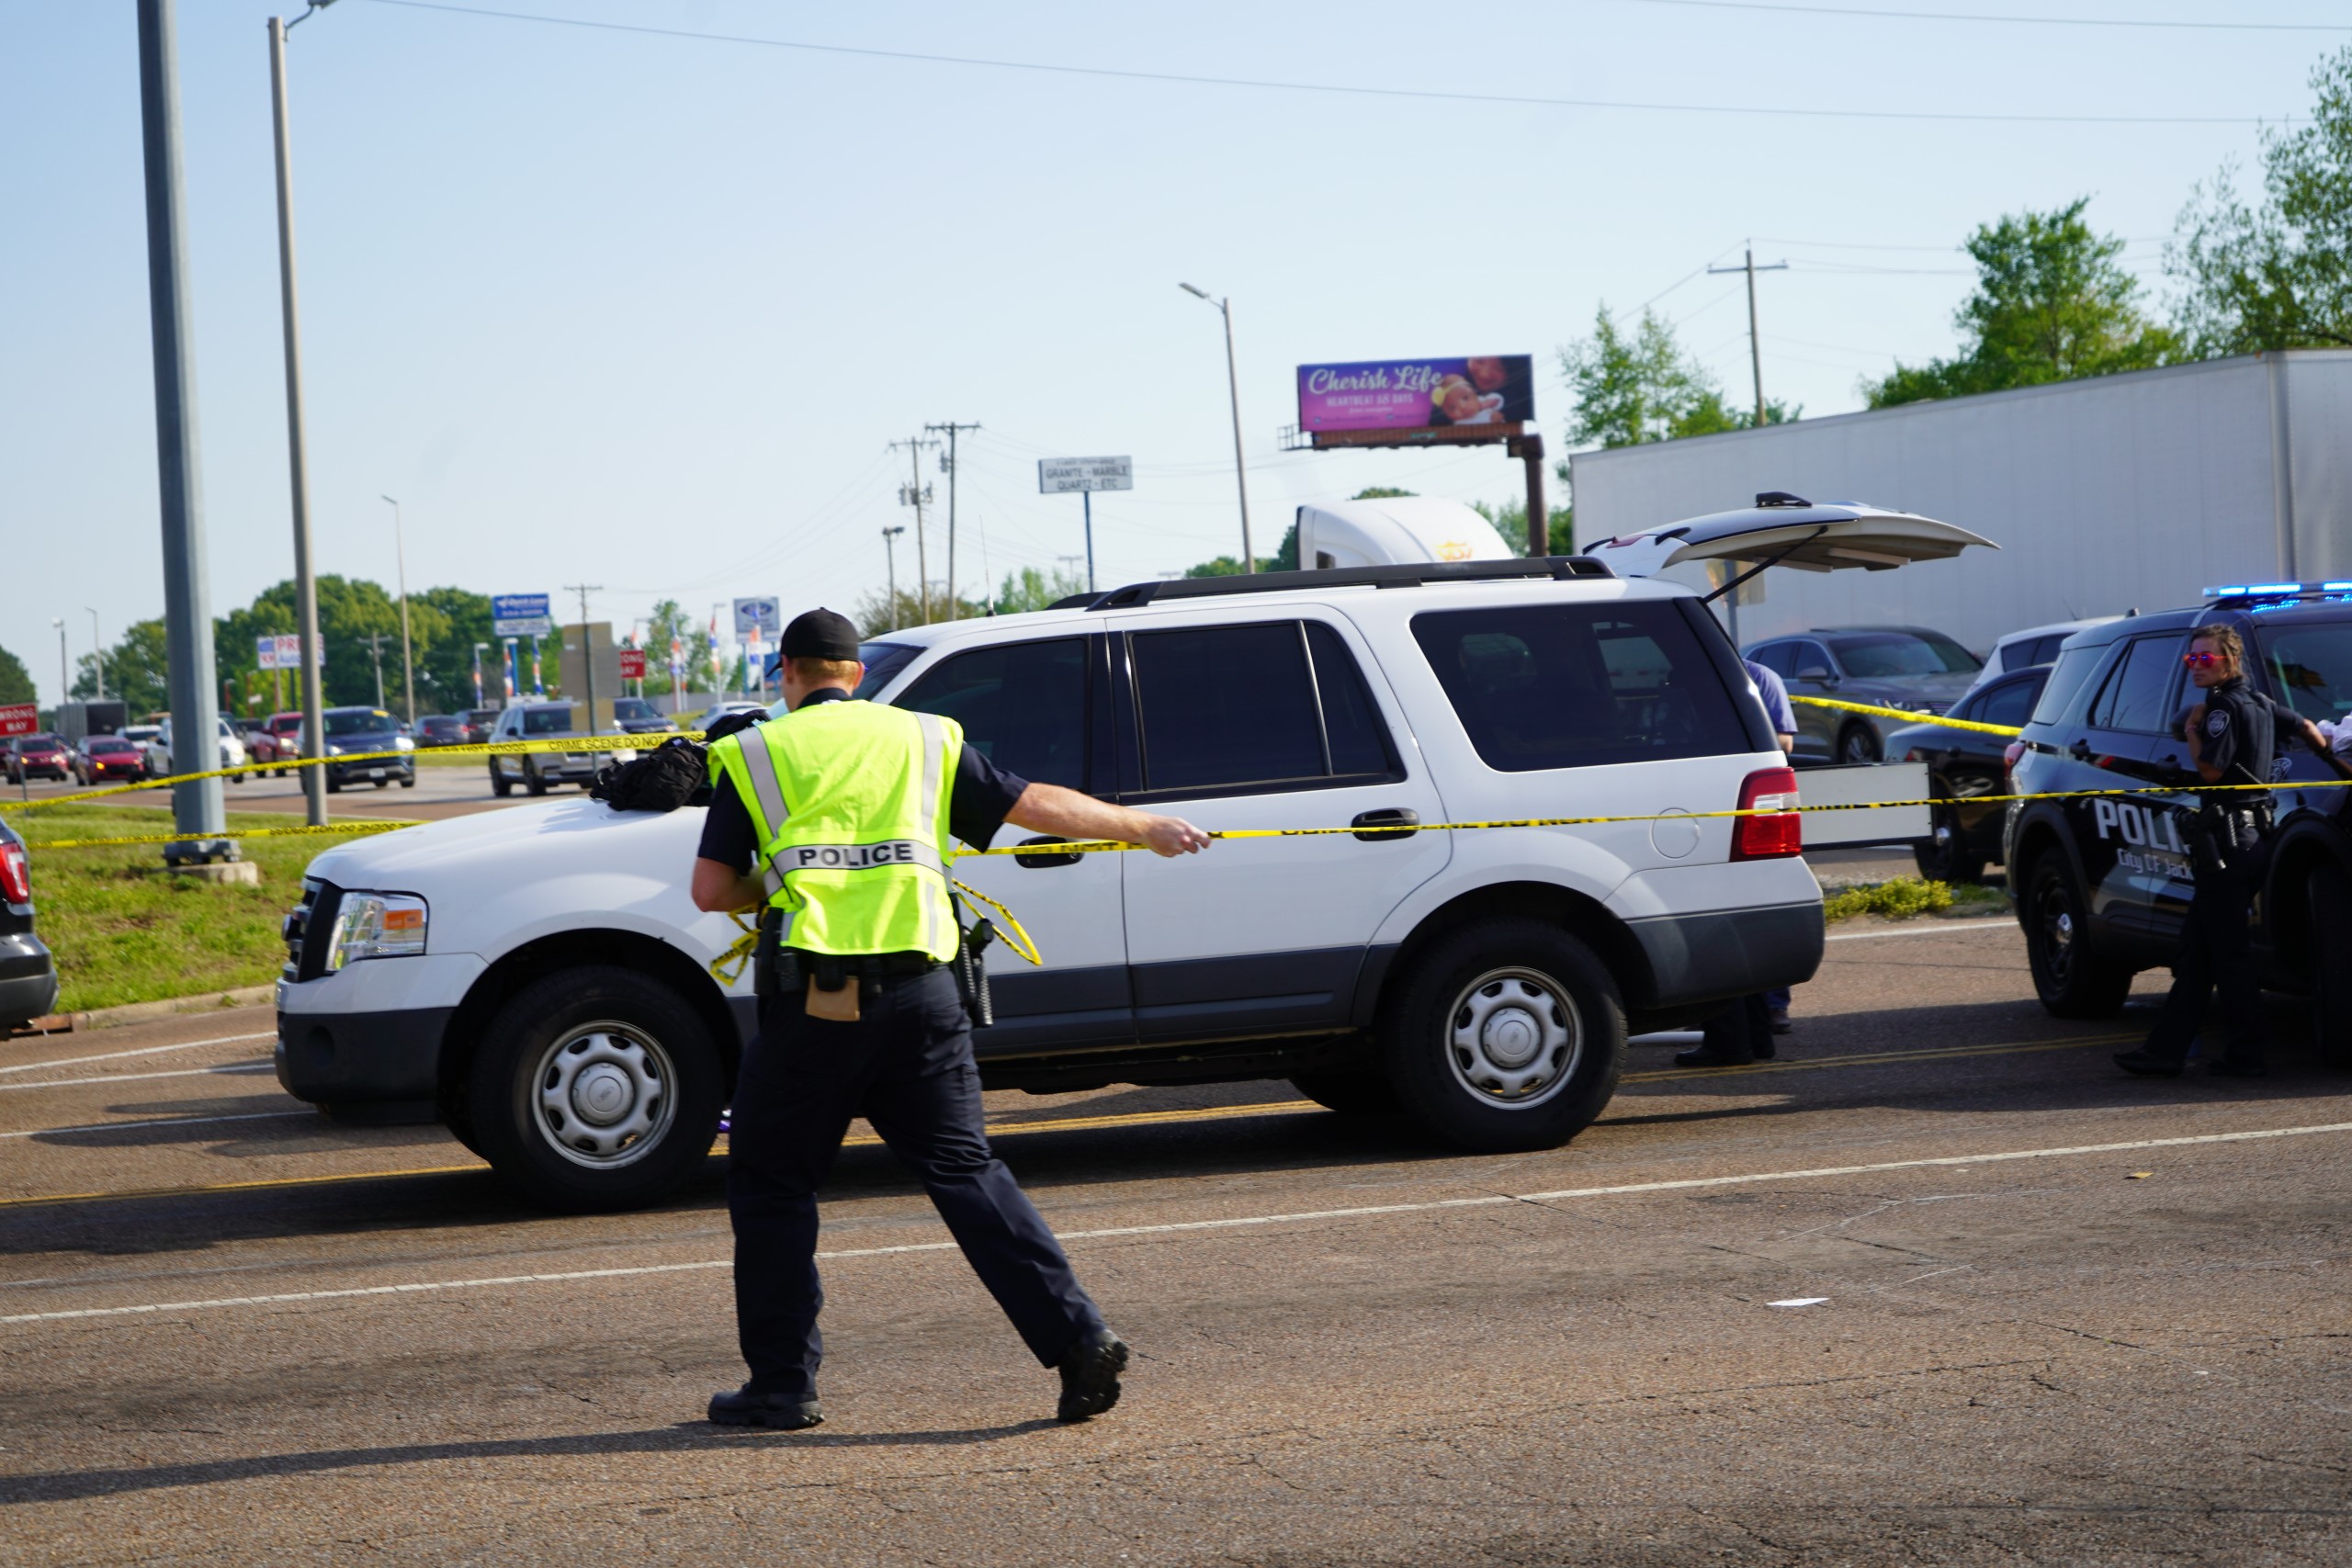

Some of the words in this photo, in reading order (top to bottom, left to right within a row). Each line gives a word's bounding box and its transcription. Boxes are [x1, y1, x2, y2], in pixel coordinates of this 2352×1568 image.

[1308, 366, 1390, 394] Cherish
[1393, 365, 1443, 392] Life
[1326, 393, 1374, 407] HEARTBEAT
[1393, 392, 1414, 404] DAYS
[1046, 468, 1083, 479] GRANITE
[1092, 466, 1128, 477] MARBLE
[1057, 479, 1091, 491] QUARTZ
[1101, 479, 1118, 489] ETC
[621, 653, 644, 662] ONG
[622, 665, 637, 674] AY
[6, 721, 28, 732] WAY
[548, 739, 583, 751] CRIME
[586, 738, 623, 750] SCENE
[626, 736, 640, 749] DO
[642, 735, 663, 748] NOT
[2094, 797, 2191, 855] POLI
[798, 843, 912, 866] POLICE
[2117, 847, 2143, 874] City
[2165, 858, 2194, 880] Jack
